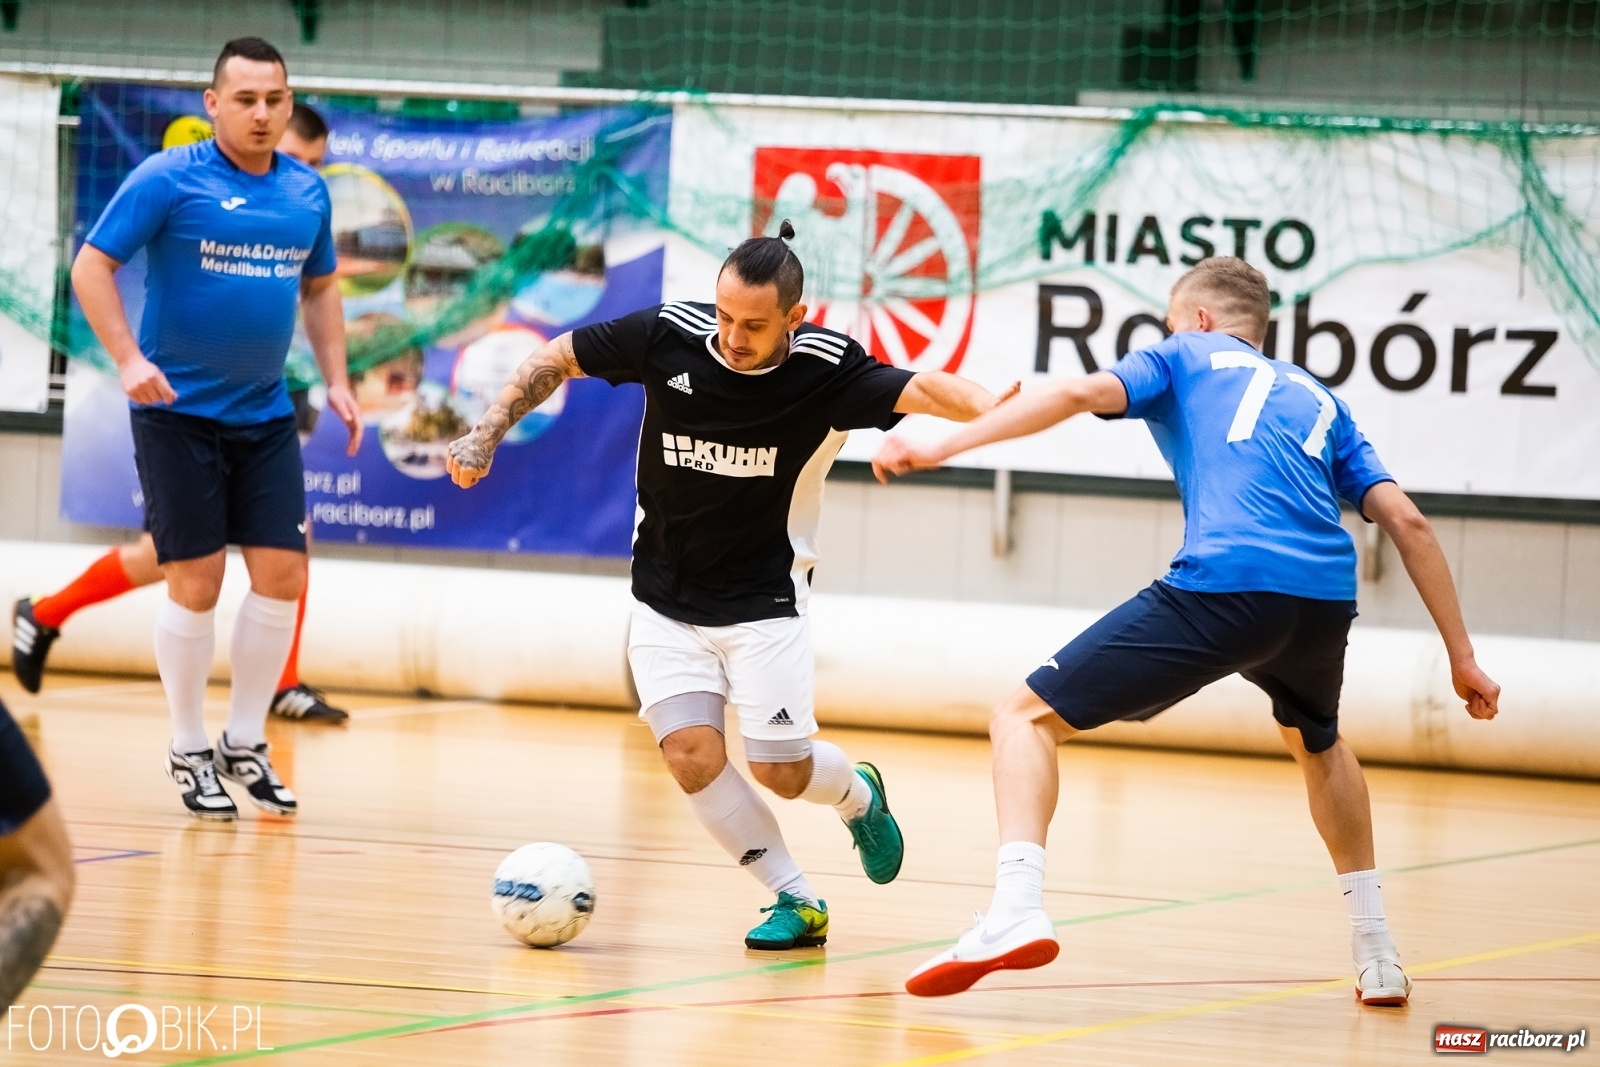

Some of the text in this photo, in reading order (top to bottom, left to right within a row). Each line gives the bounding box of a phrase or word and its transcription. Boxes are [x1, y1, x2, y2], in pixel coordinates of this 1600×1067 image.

[1038, 209, 1315, 271] MIASTO
[200, 256, 272, 278] Metallbau
[667, 379, 693, 395] adidas
[693, 439, 778, 466] KUHN
[684, 457, 714, 471] PRD
